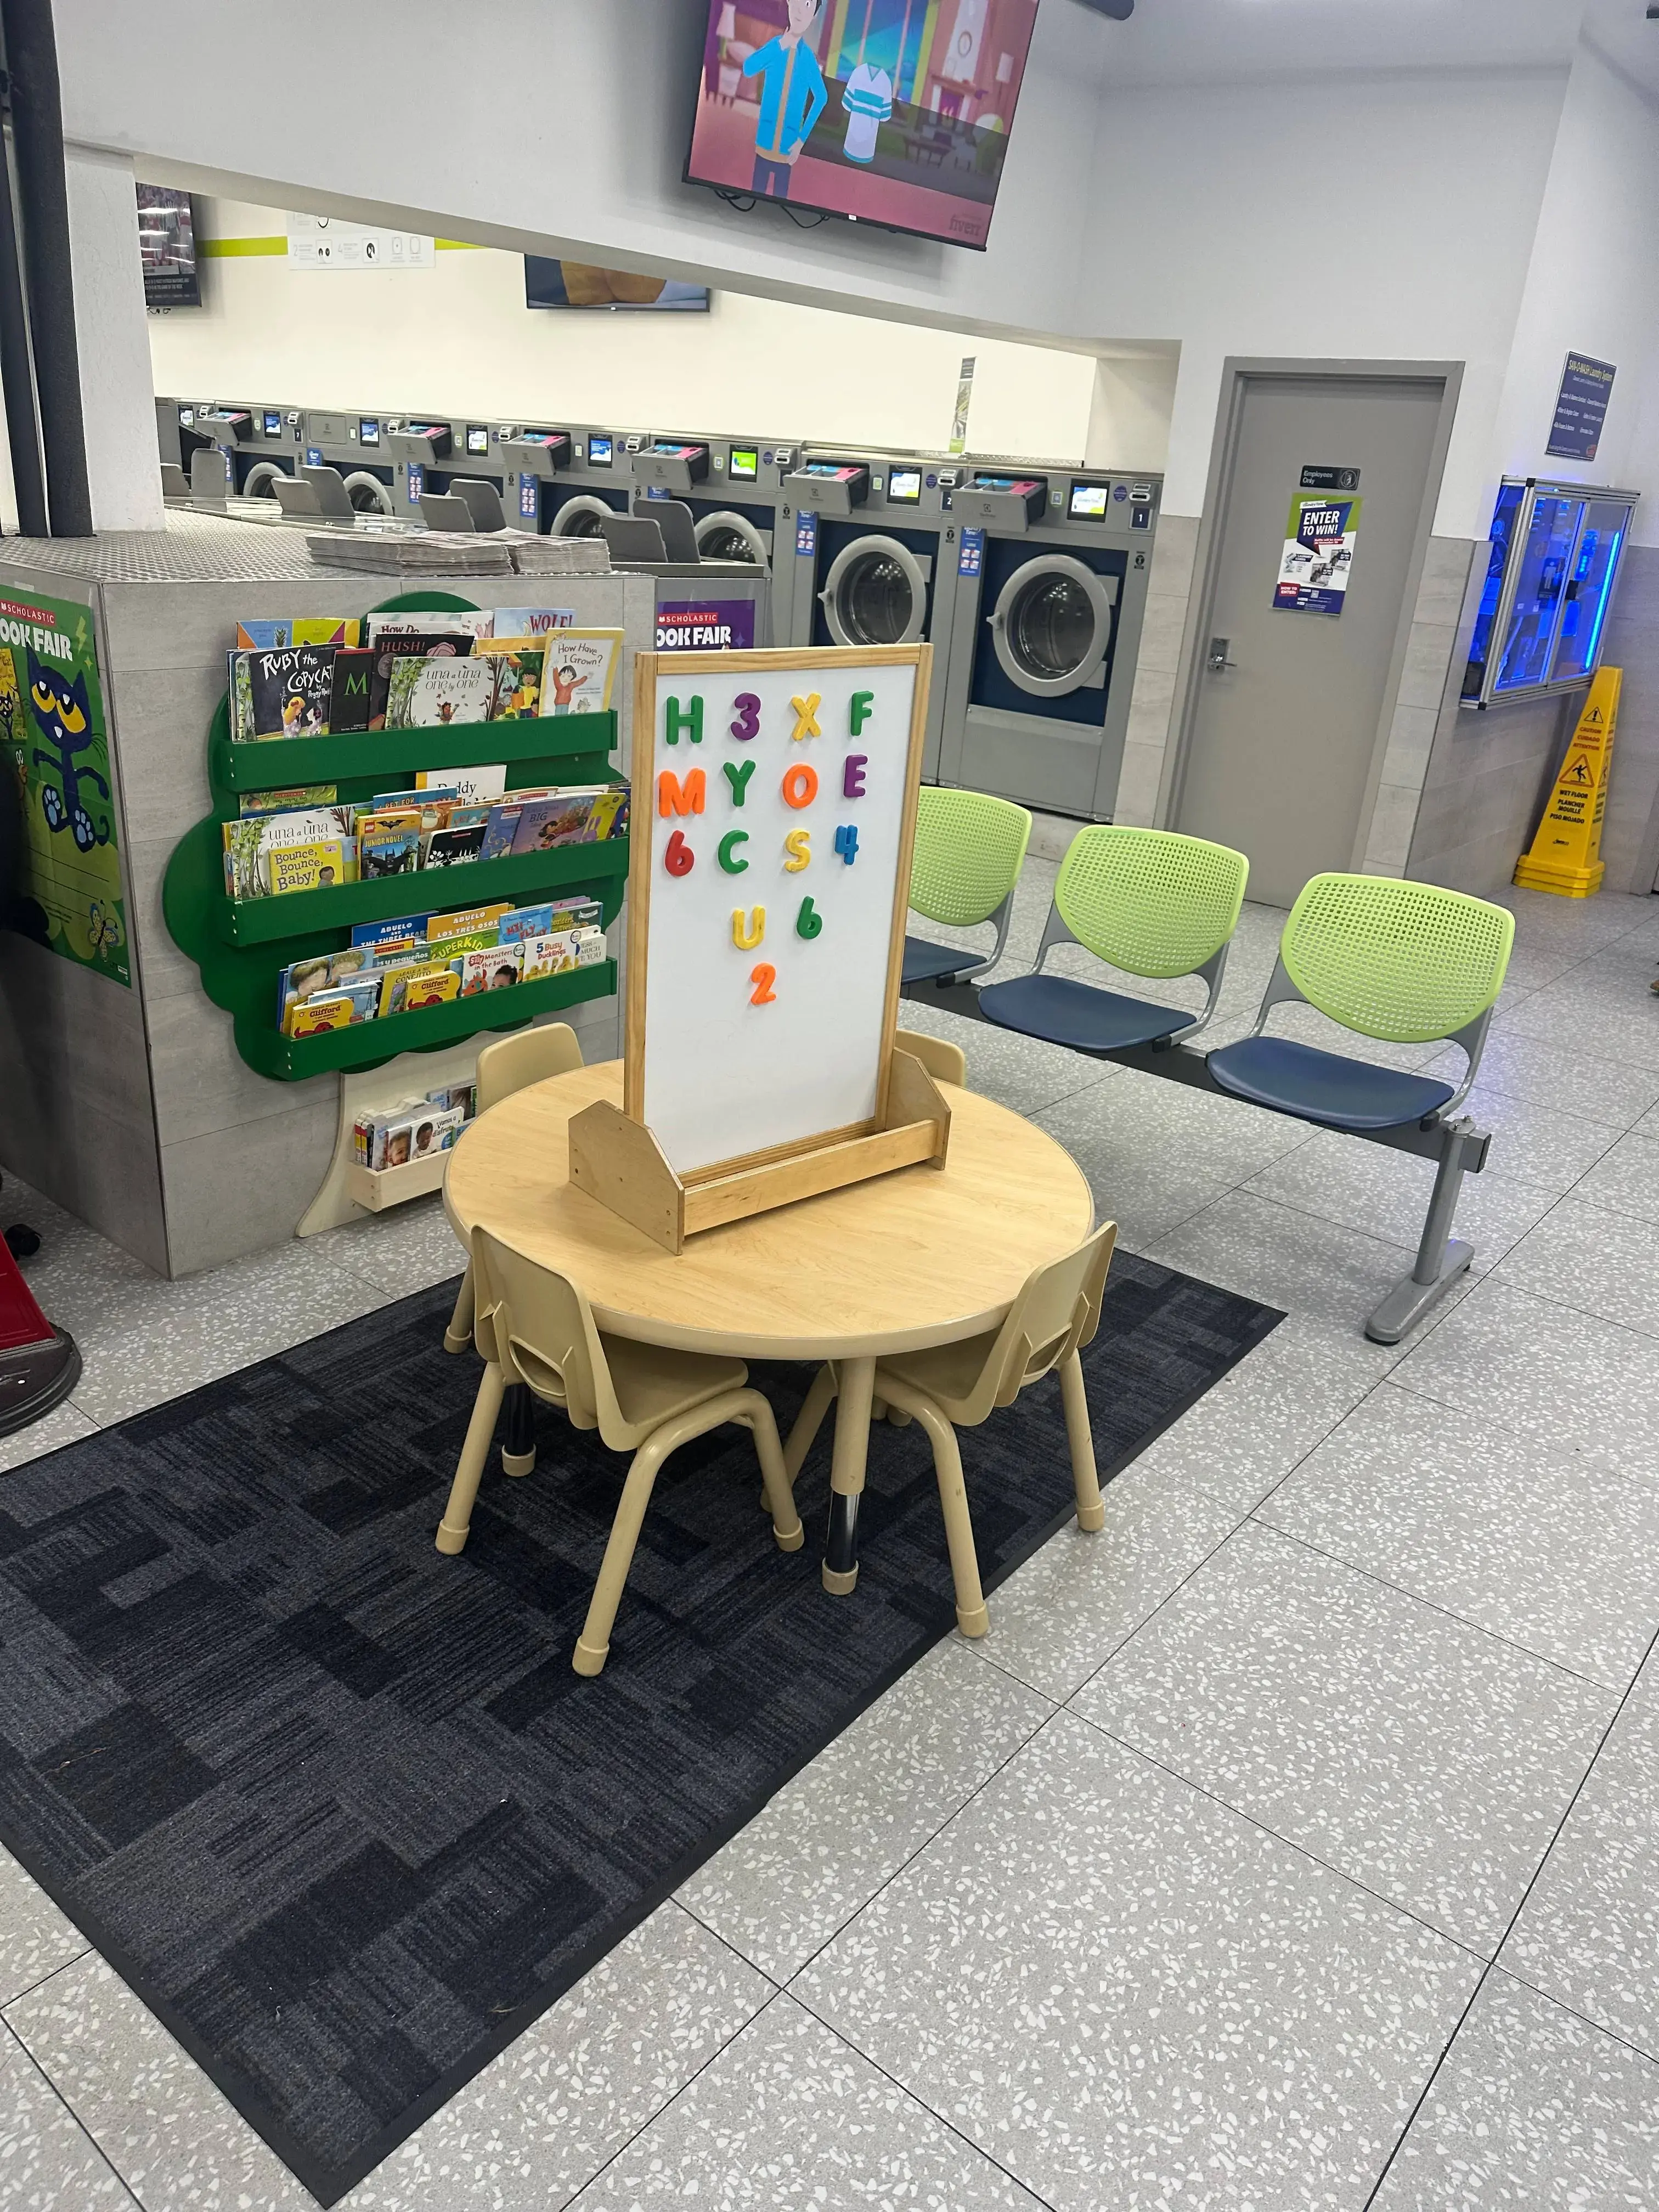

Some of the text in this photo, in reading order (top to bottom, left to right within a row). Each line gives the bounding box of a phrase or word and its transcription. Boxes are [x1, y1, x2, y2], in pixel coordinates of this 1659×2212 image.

[1138, 514, 1143, 522] 1
[1303, 510, 1340, 525] ENTER
[1303, 524, 1339, 536] TO WIN!
[8, 604, 54, 624] SCHOLASTIC
[666, 614, 716, 623] SCHOLASTIC
[381, 624, 404, 633] How
[0, 618, 73, 662] OOK FAIR
[657, 626, 731, 647] OOK FAIR
[381, 641, 426, 652] HUSH!
[558, 643, 597, 656] How Have
[259, 650, 318, 680] RUBY the
[564, 654, 603, 666] I Grown?
[426, 670, 450, 680] una
[458, 669, 481, 679] una
[425, 679, 448, 690] one
[456, 678, 479, 689] one
[308, 689, 321, 699] Peggy
[666, 691, 874, 745] H 3 X F
[438, 781, 477, 797] Dddy
[659, 754, 868, 817] M Y O E
[402, 797, 415, 805] FOR
[1558, 799, 1585, 808] PLANCHER
[529, 812, 548, 822] BIG
[1562, 815, 1585, 824] MOJADO
[269, 827, 295, 840] una
[303, 823, 329, 835] una
[365, 838, 385, 848] JUNIOR
[274, 849, 317, 865] Bounce,
[665, 825, 859, 877] 6 C S 4
[279, 859, 323, 875] Bounce,
[276, 869, 315, 891] Baby!
[453, 912, 486, 924] ABUELO
[381, 922, 413, 933] ABUELO
[437, 919, 498, 938] LOS TRES OSOS
[733, 906, 765, 950] U
[536, 942, 562, 953] 5 Busy
[470, 950, 512, 964] Silly Monsters
[538, 948, 566, 960] Ducklings
[586, 951, 601, 961] YOU
[396, 970, 431, 984] CONEJITO
[421, 979, 450, 990] Clifford
[750, 962, 776, 1005] 2
[309, 1005, 341, 1018] Clifford
